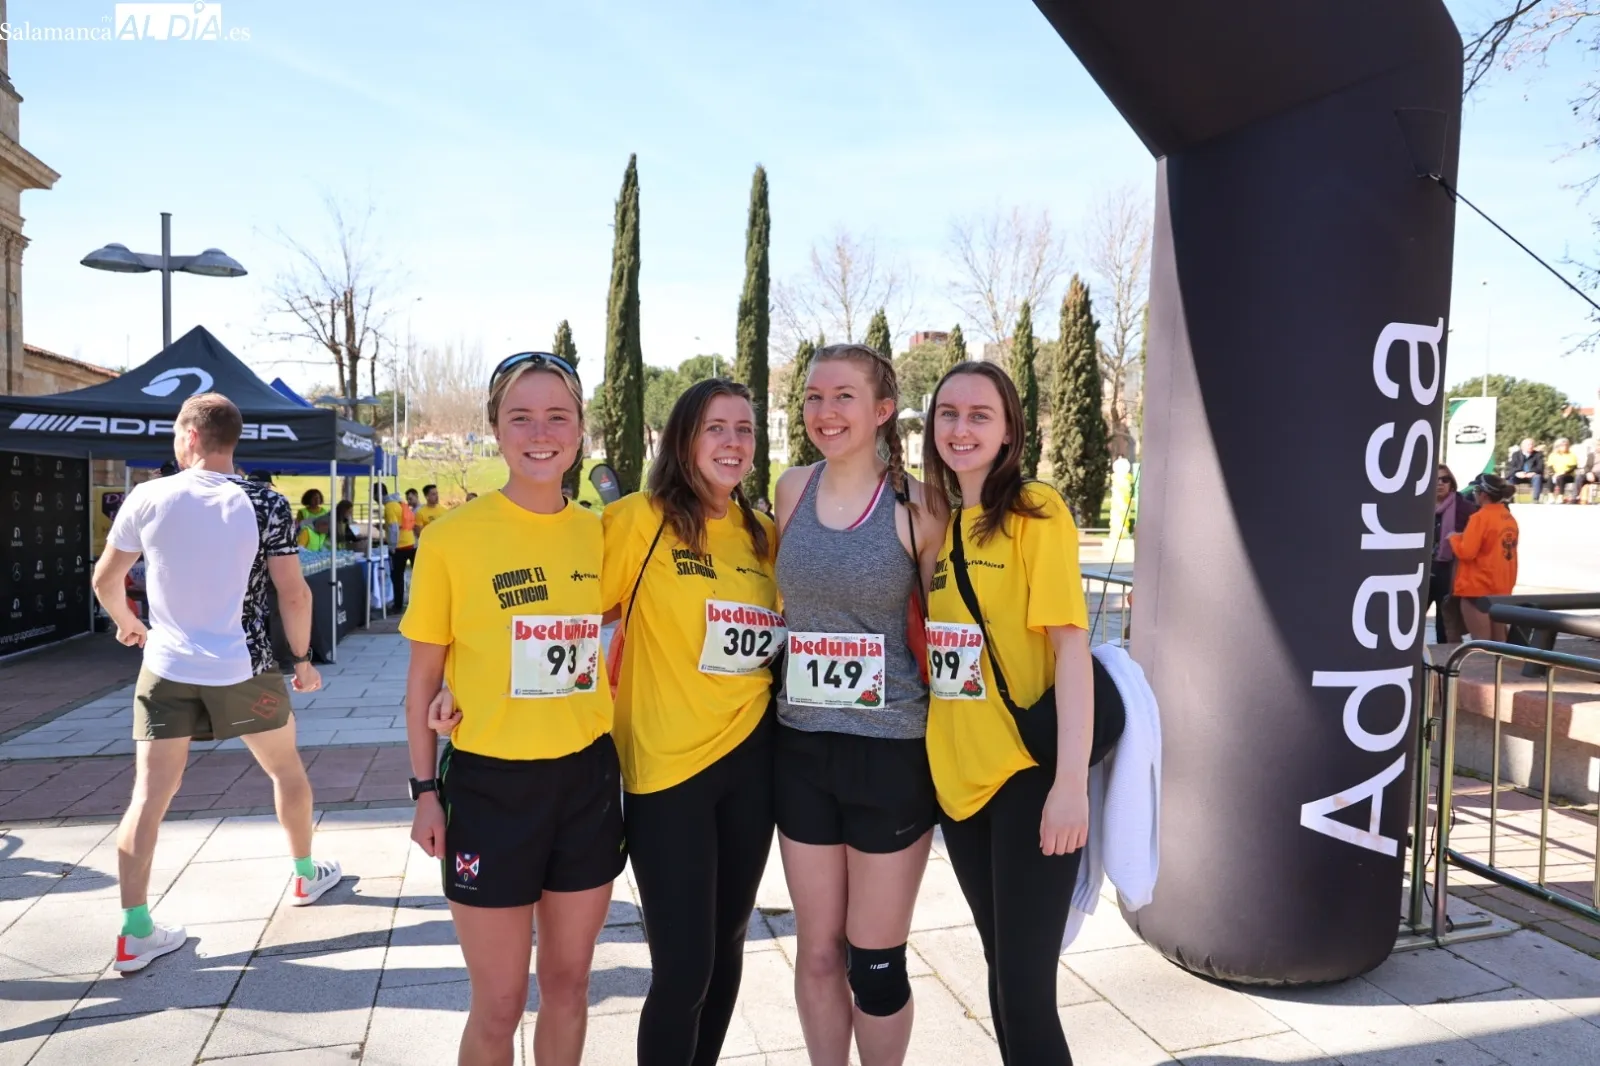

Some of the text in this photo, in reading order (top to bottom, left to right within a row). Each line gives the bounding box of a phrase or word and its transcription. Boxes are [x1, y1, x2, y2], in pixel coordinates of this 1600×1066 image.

[704, 553, 714, 568] EL
[492, 566, 548, 595] ¡ROMPE EL
[1300, 316, 1444, 858] Adarsa
[498, 584, 549, 610] SILENCIO!
[707, 603, 787, 628] bedunia
[515, 619, 599, 641] bedunia
[723, 627, 773, 657] 302
[790, 635, 882, 657] bedunia
[546, 644, 577, 676] 93
[806, 659, 863, 690] 149
